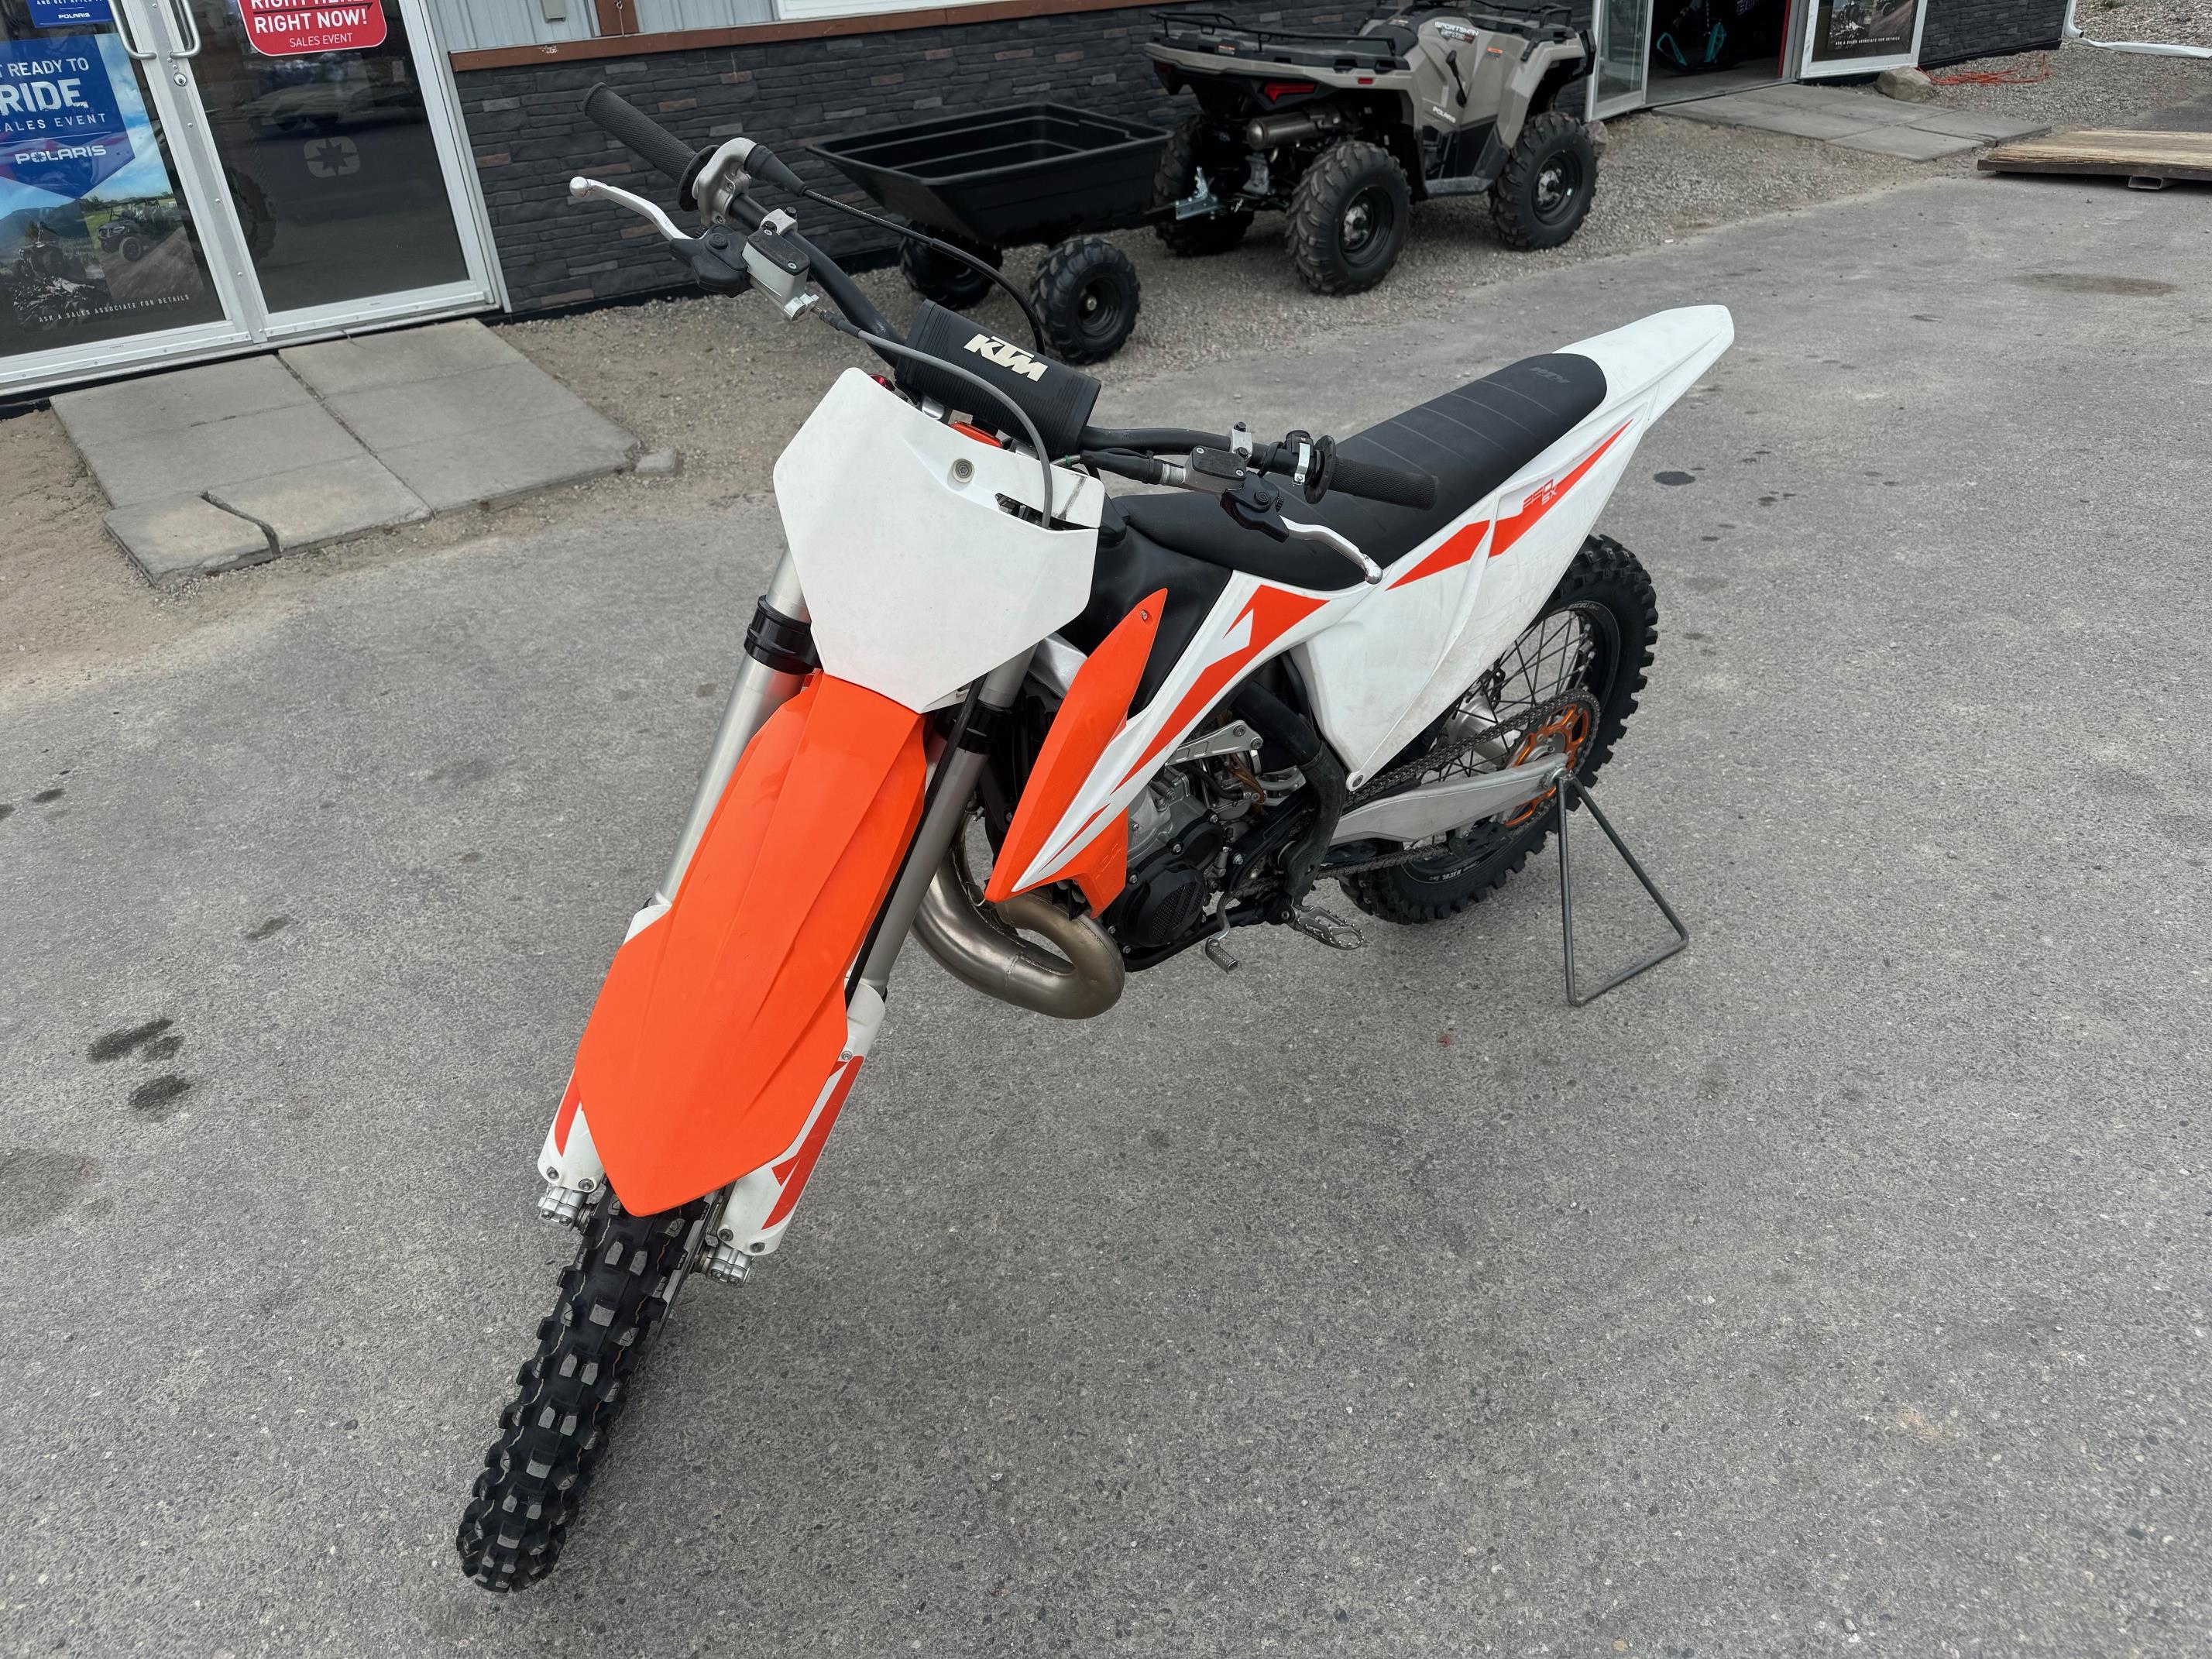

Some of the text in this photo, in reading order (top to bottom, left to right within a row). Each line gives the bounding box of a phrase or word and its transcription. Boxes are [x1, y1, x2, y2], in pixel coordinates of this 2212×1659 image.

[254, 9, 368, 34] RIGHT NOW!
[289, 33, 353, 48] SALES EVENT
[7, 59, 62, 77] READY
[66, 57, 90, 72] TO
[0, 78, 89, 116] RIDE
[0, 113, 106, 132] ALES EVENT
[15, 145, 107, 164] POLARIS
[66, 309, 91, 318] SALES
[94, 302, 137, 314] ASSOCIATE
[158, 294, 190, 304] DETAILS
[963, 333, 1049, 382] KTM
